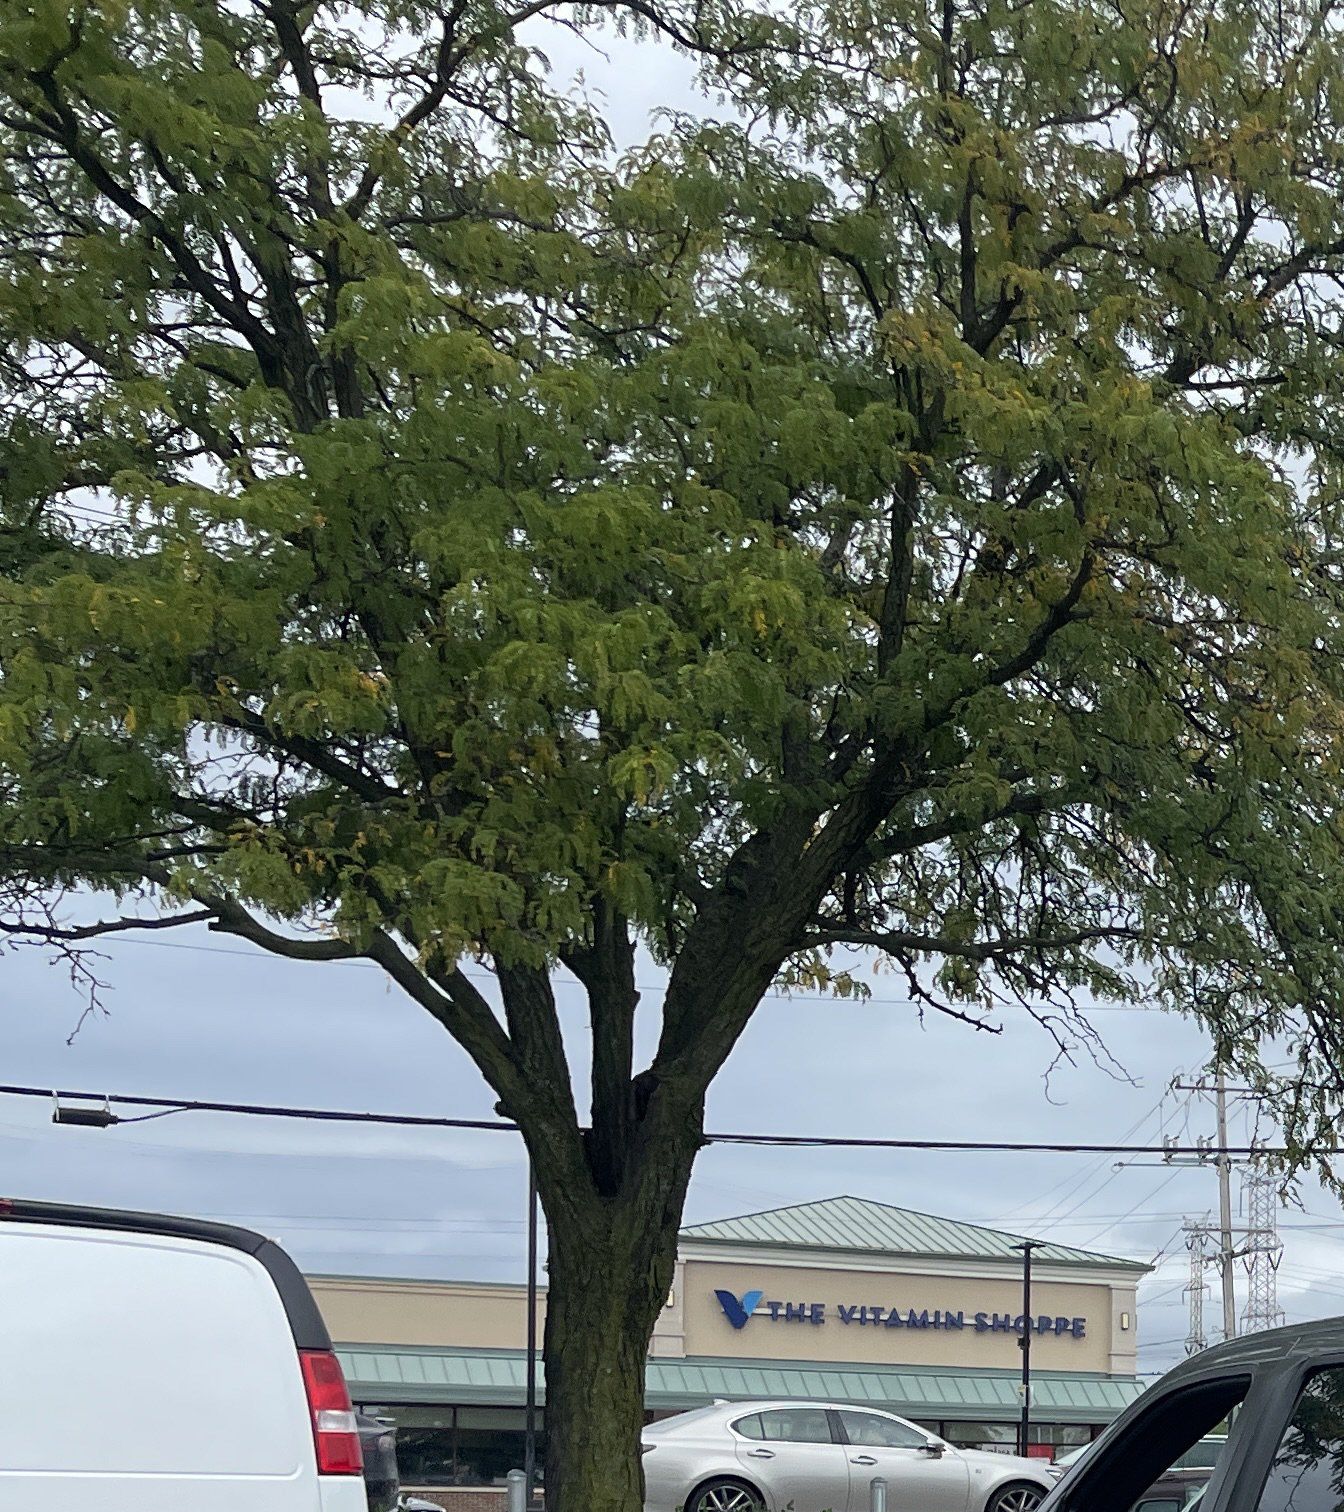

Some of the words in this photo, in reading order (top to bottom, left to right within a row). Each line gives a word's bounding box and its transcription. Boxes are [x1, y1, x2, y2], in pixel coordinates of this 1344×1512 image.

[766, 1300, 826, 1325] THE
[837, 1304, 964, 1331] VITAMIN
[974, 1312, 1087, 1339] SHOPPE
